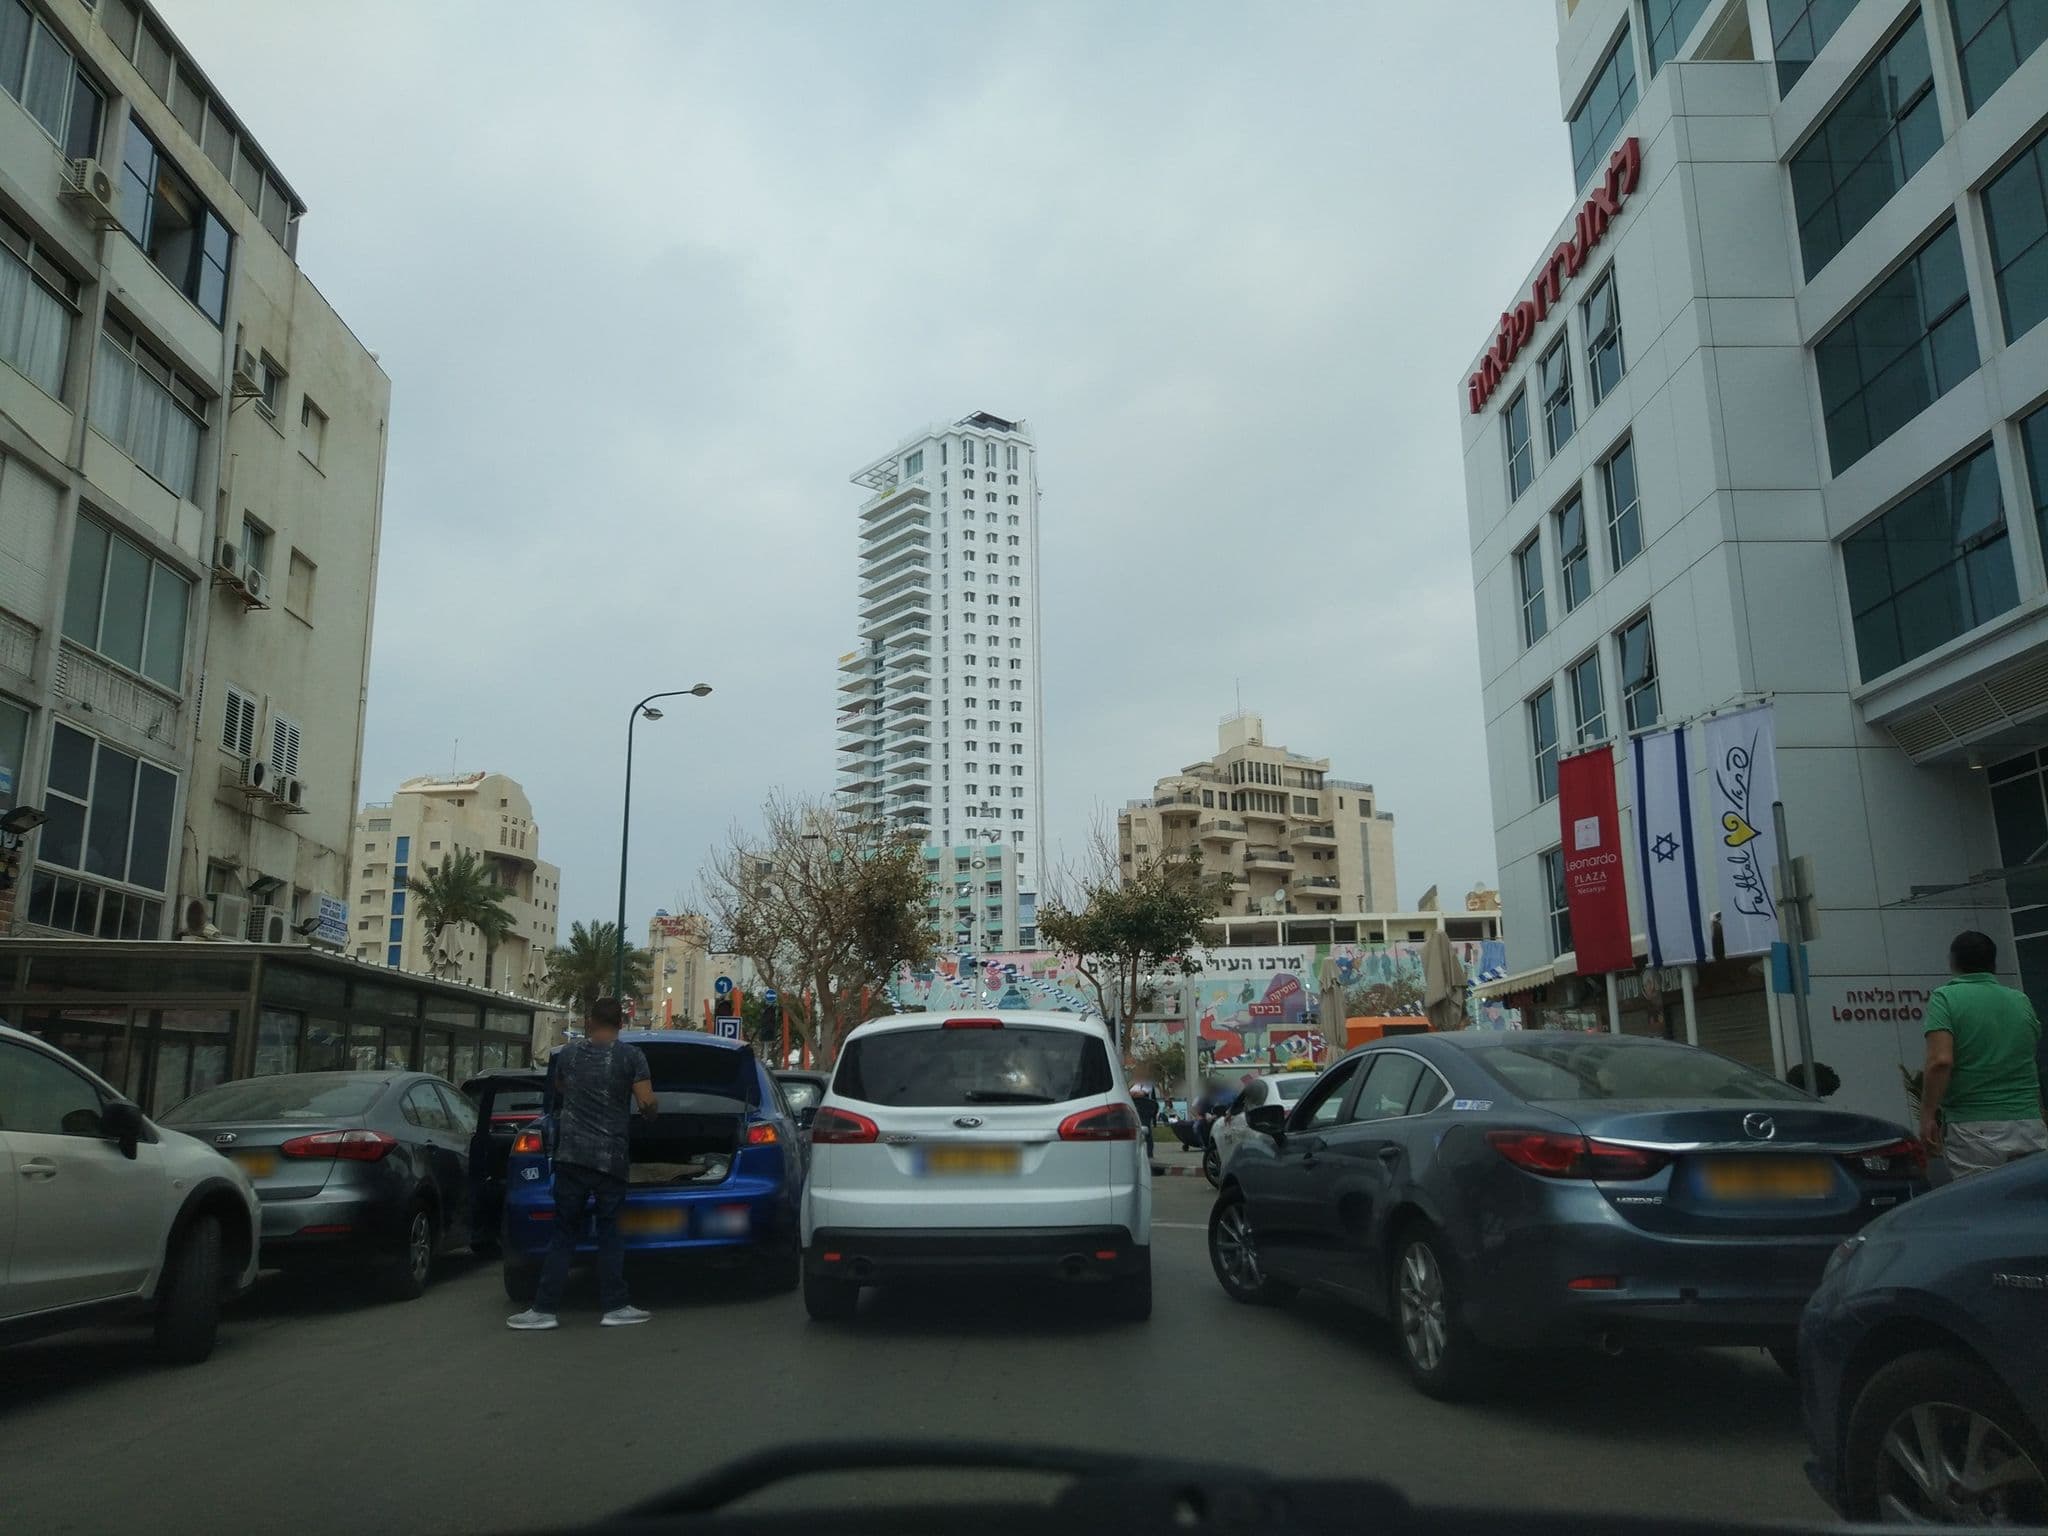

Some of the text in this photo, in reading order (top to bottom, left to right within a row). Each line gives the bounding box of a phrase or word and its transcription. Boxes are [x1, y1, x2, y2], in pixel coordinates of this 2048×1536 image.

[1467, 136, 1641, 414] לאונרדו פלאזה
[1566, 852, 1617, 872] Leonardo
[1573, 871, 1608, 885] PLAZA
[1212, 957, 1252, 972] העיר
[1258, 956, 1302, 971] מרכז
[1269, 981, 1298, 1001] מוסיקה
[1846, 987, 1896, 1003] פלאזה
[1250, 1004, 1282, 1015] בכיכר
[1832, 1005, 1922, 1021] Leonardo
[725, 1023, 735, 1038] P
